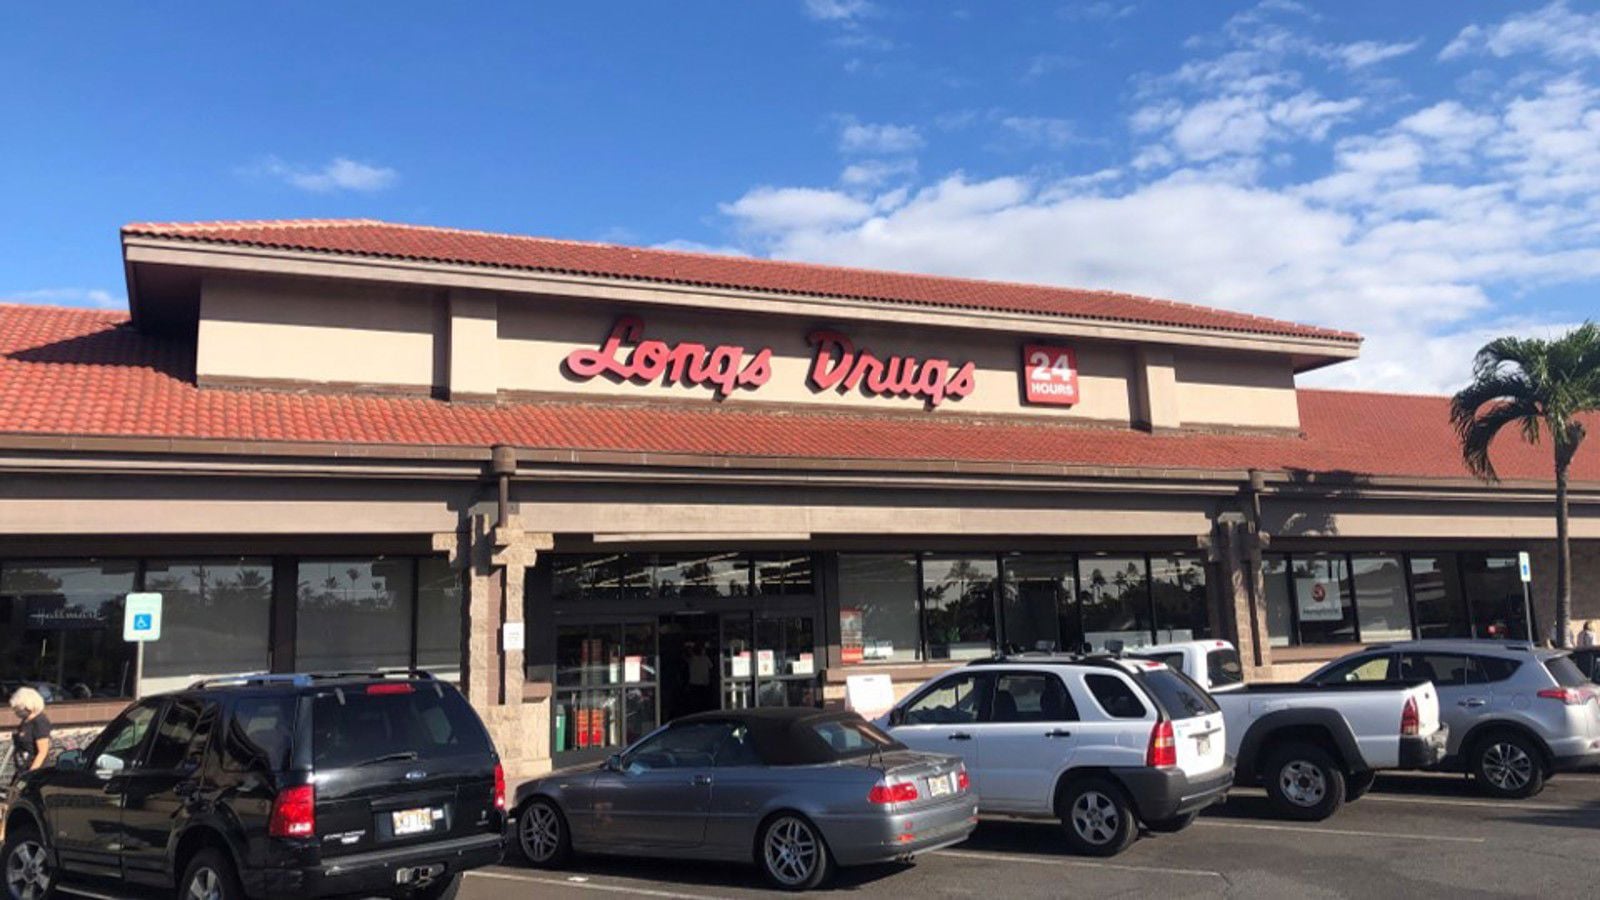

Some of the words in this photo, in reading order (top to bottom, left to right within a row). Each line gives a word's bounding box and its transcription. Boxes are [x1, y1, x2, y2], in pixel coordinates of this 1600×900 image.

[567, 315, 772, 396] Longs
[807, 330, 976, 406] Drugs
[1030, 351, 1070, 382] 24
[1031, 382, 1074, 396] HOURS
